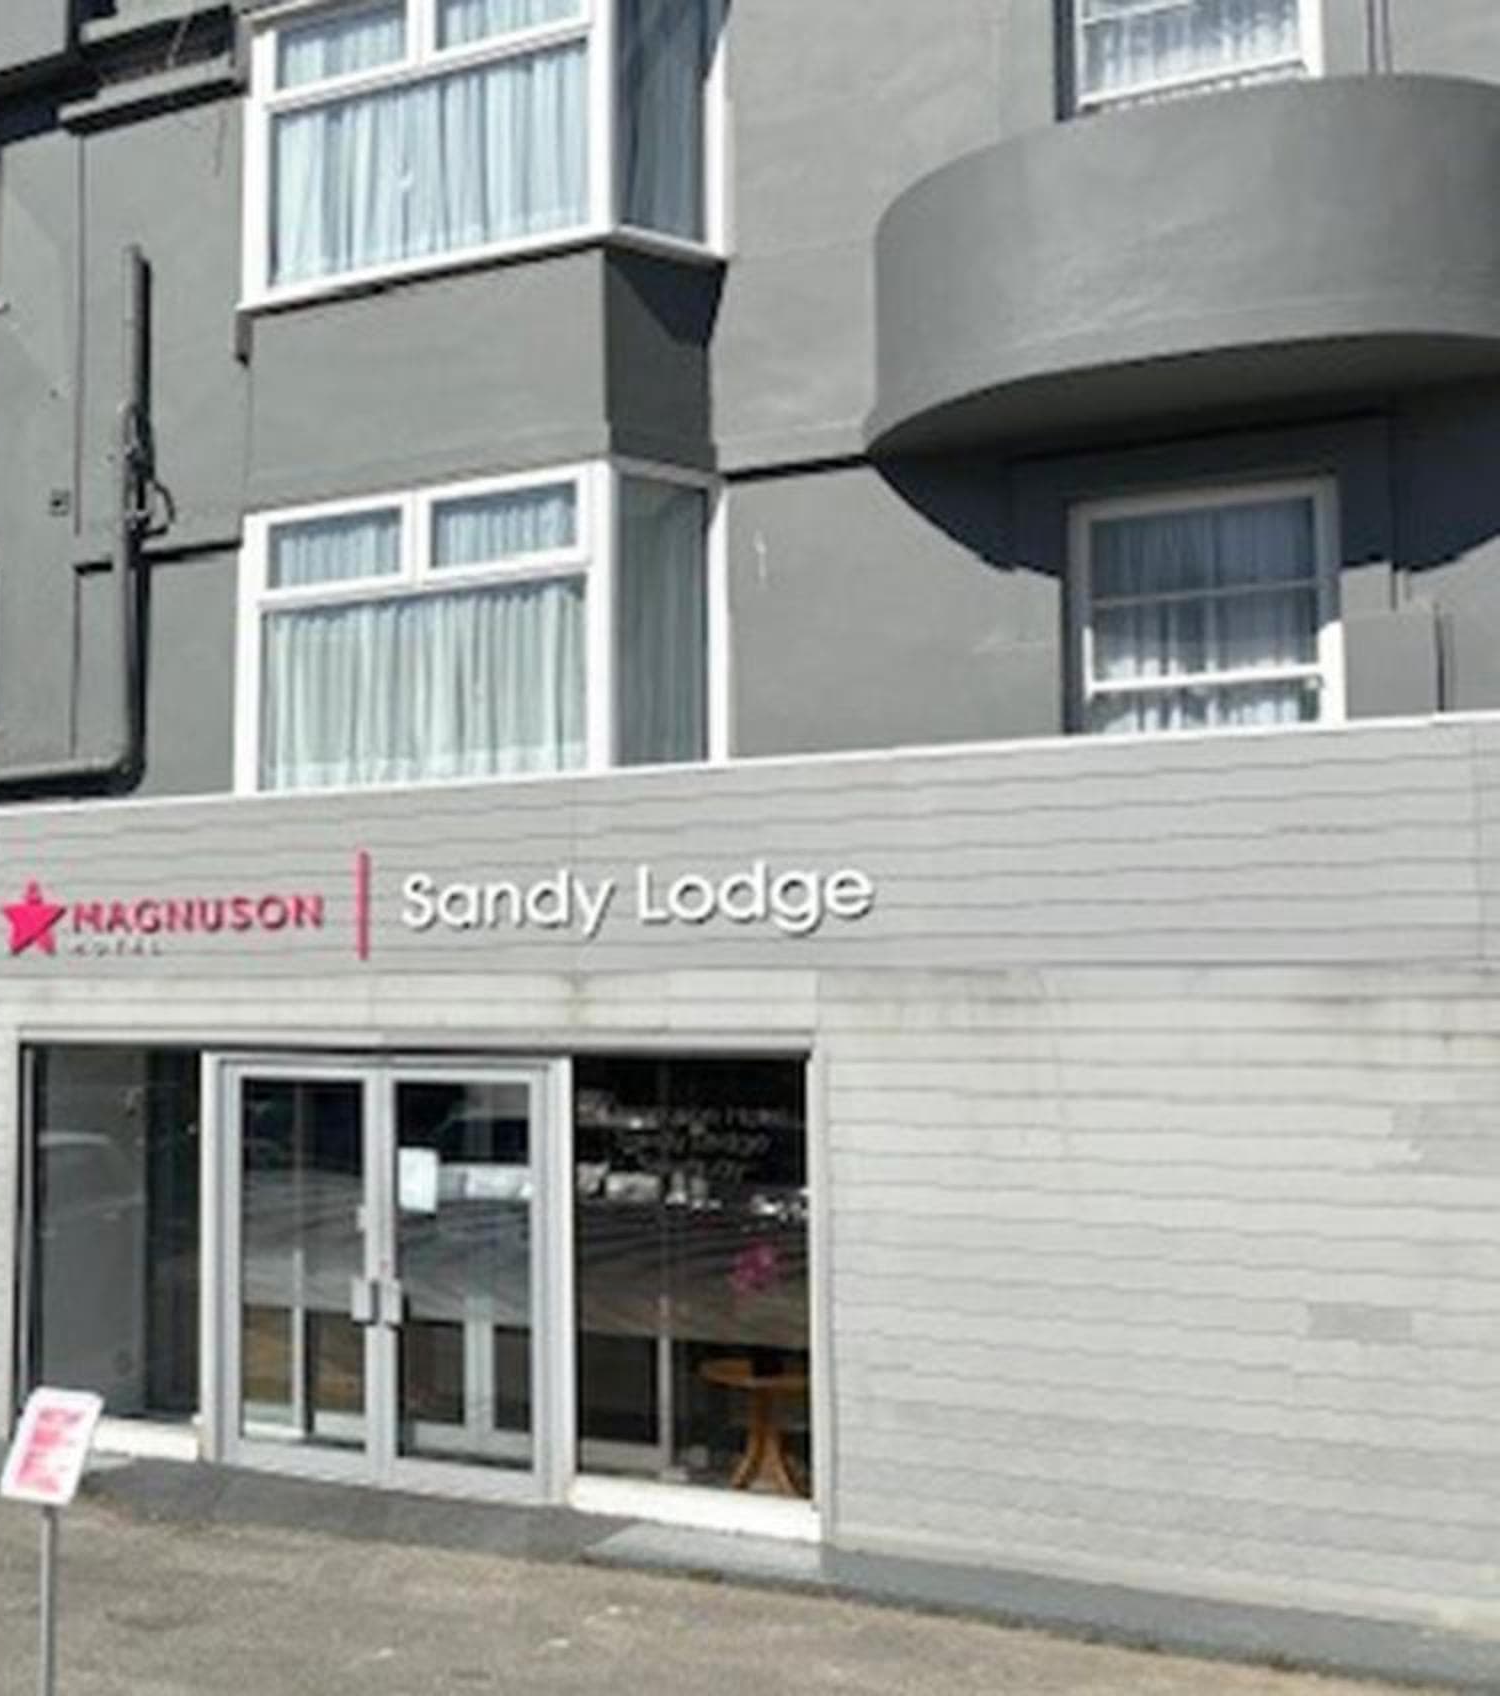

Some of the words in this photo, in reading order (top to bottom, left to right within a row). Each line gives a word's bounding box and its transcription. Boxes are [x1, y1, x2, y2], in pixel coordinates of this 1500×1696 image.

[72, 894, 325, 934] MAGNUSON
[401, 868, 616, 938] Sandy
[637, 858, 876, 937] Lodge
